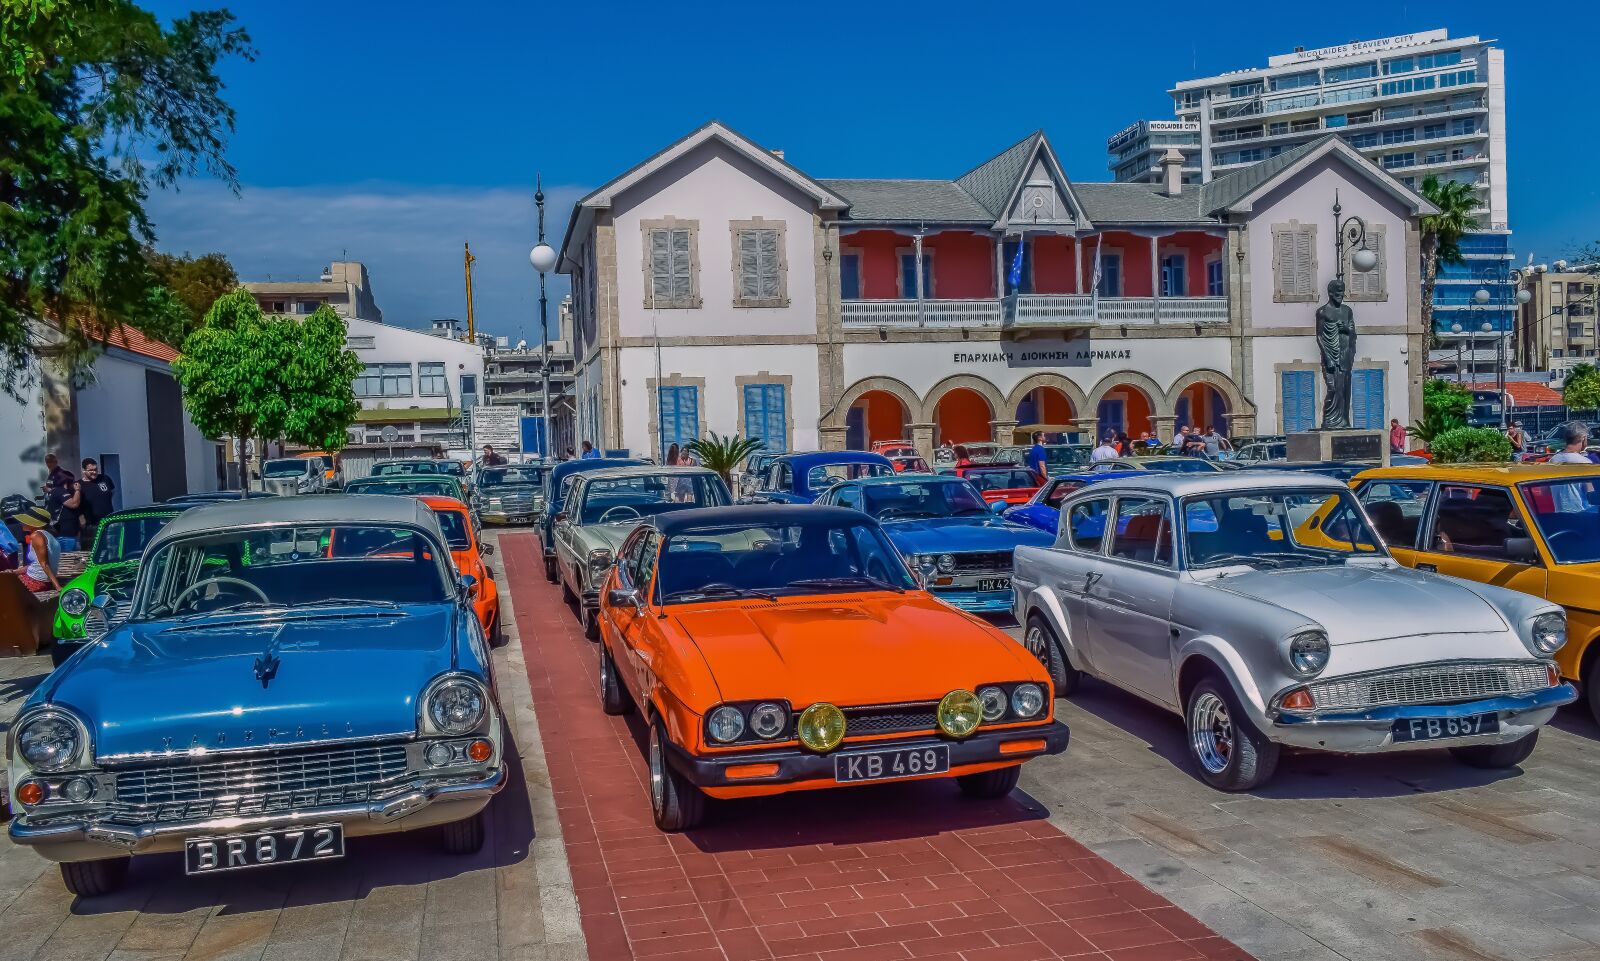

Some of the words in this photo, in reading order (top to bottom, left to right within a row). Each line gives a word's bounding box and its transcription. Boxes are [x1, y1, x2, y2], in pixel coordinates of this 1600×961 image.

[1298, 45, 1348, 59] NICOLAIDES
[1352, 39, 1390, 51] SEAVIEW
[1394, 35, 1414, 44] CITY
[953, 353, 1013, 363] ΕΠΑΡΧΙΑΚΗ
[1020, 351, 1069, 361] ΔΙΟΙΚΗΣΗ
[1076, 350, 1131, 361] ΛΑΡΝΑΚΑΣ
[982, 580, 995, 591] HX
[997, 579, 1011, 590] 42
[1409, 719, 1441, 739] FB
[1447, 714, 1483, 735] 657
[848, 755, 883, 779] KB
[892, 750, 937, 774] 469
